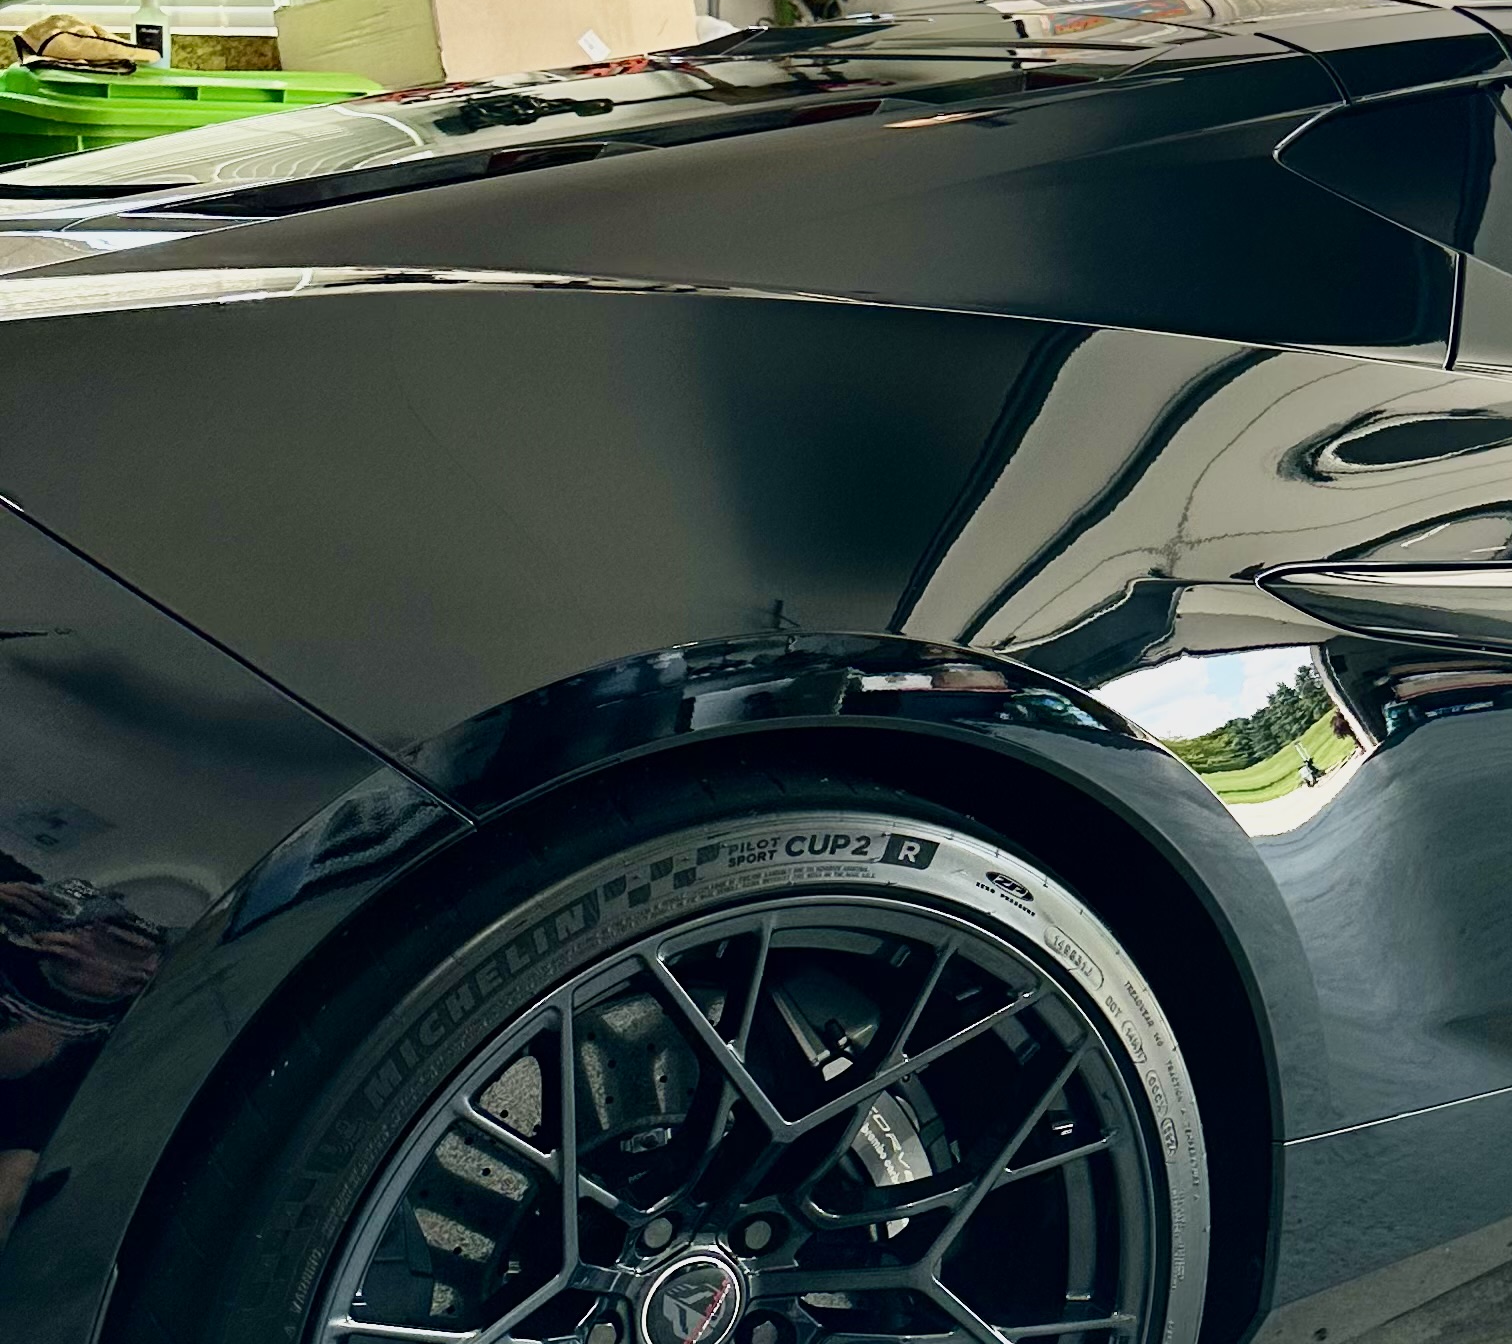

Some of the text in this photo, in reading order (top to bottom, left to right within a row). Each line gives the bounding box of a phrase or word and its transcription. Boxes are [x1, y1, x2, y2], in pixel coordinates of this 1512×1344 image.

[727, 836, 781, 856] PILOT
[728, 849, 778, 868] SPORT
[363, 902, 586, 1108] MICHELIN
